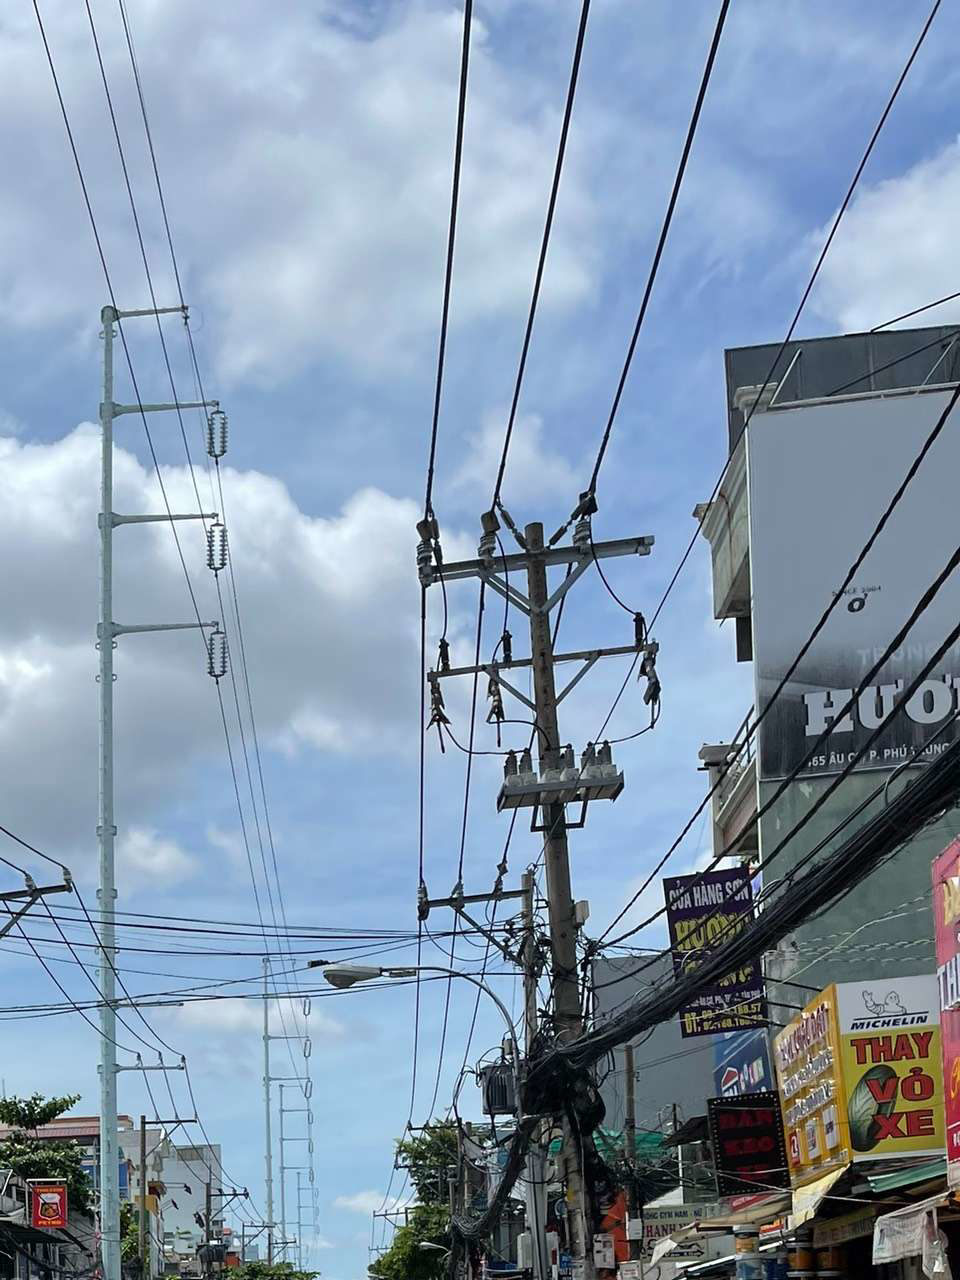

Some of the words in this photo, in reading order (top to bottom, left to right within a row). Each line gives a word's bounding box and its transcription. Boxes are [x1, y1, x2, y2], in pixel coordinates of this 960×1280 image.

[801, 673, 960, 737] HƯƠ
[884, 744, 907, 759] PHÚ
[693, 881, 722, 907] HÀNG
[851, 1015, 928, 1030] MICHELIN
[851, 1031, 933, 1065] THAY
[866, 1066, 935, 1104] VỎ
[872, 1109, 935, 1141] XE
